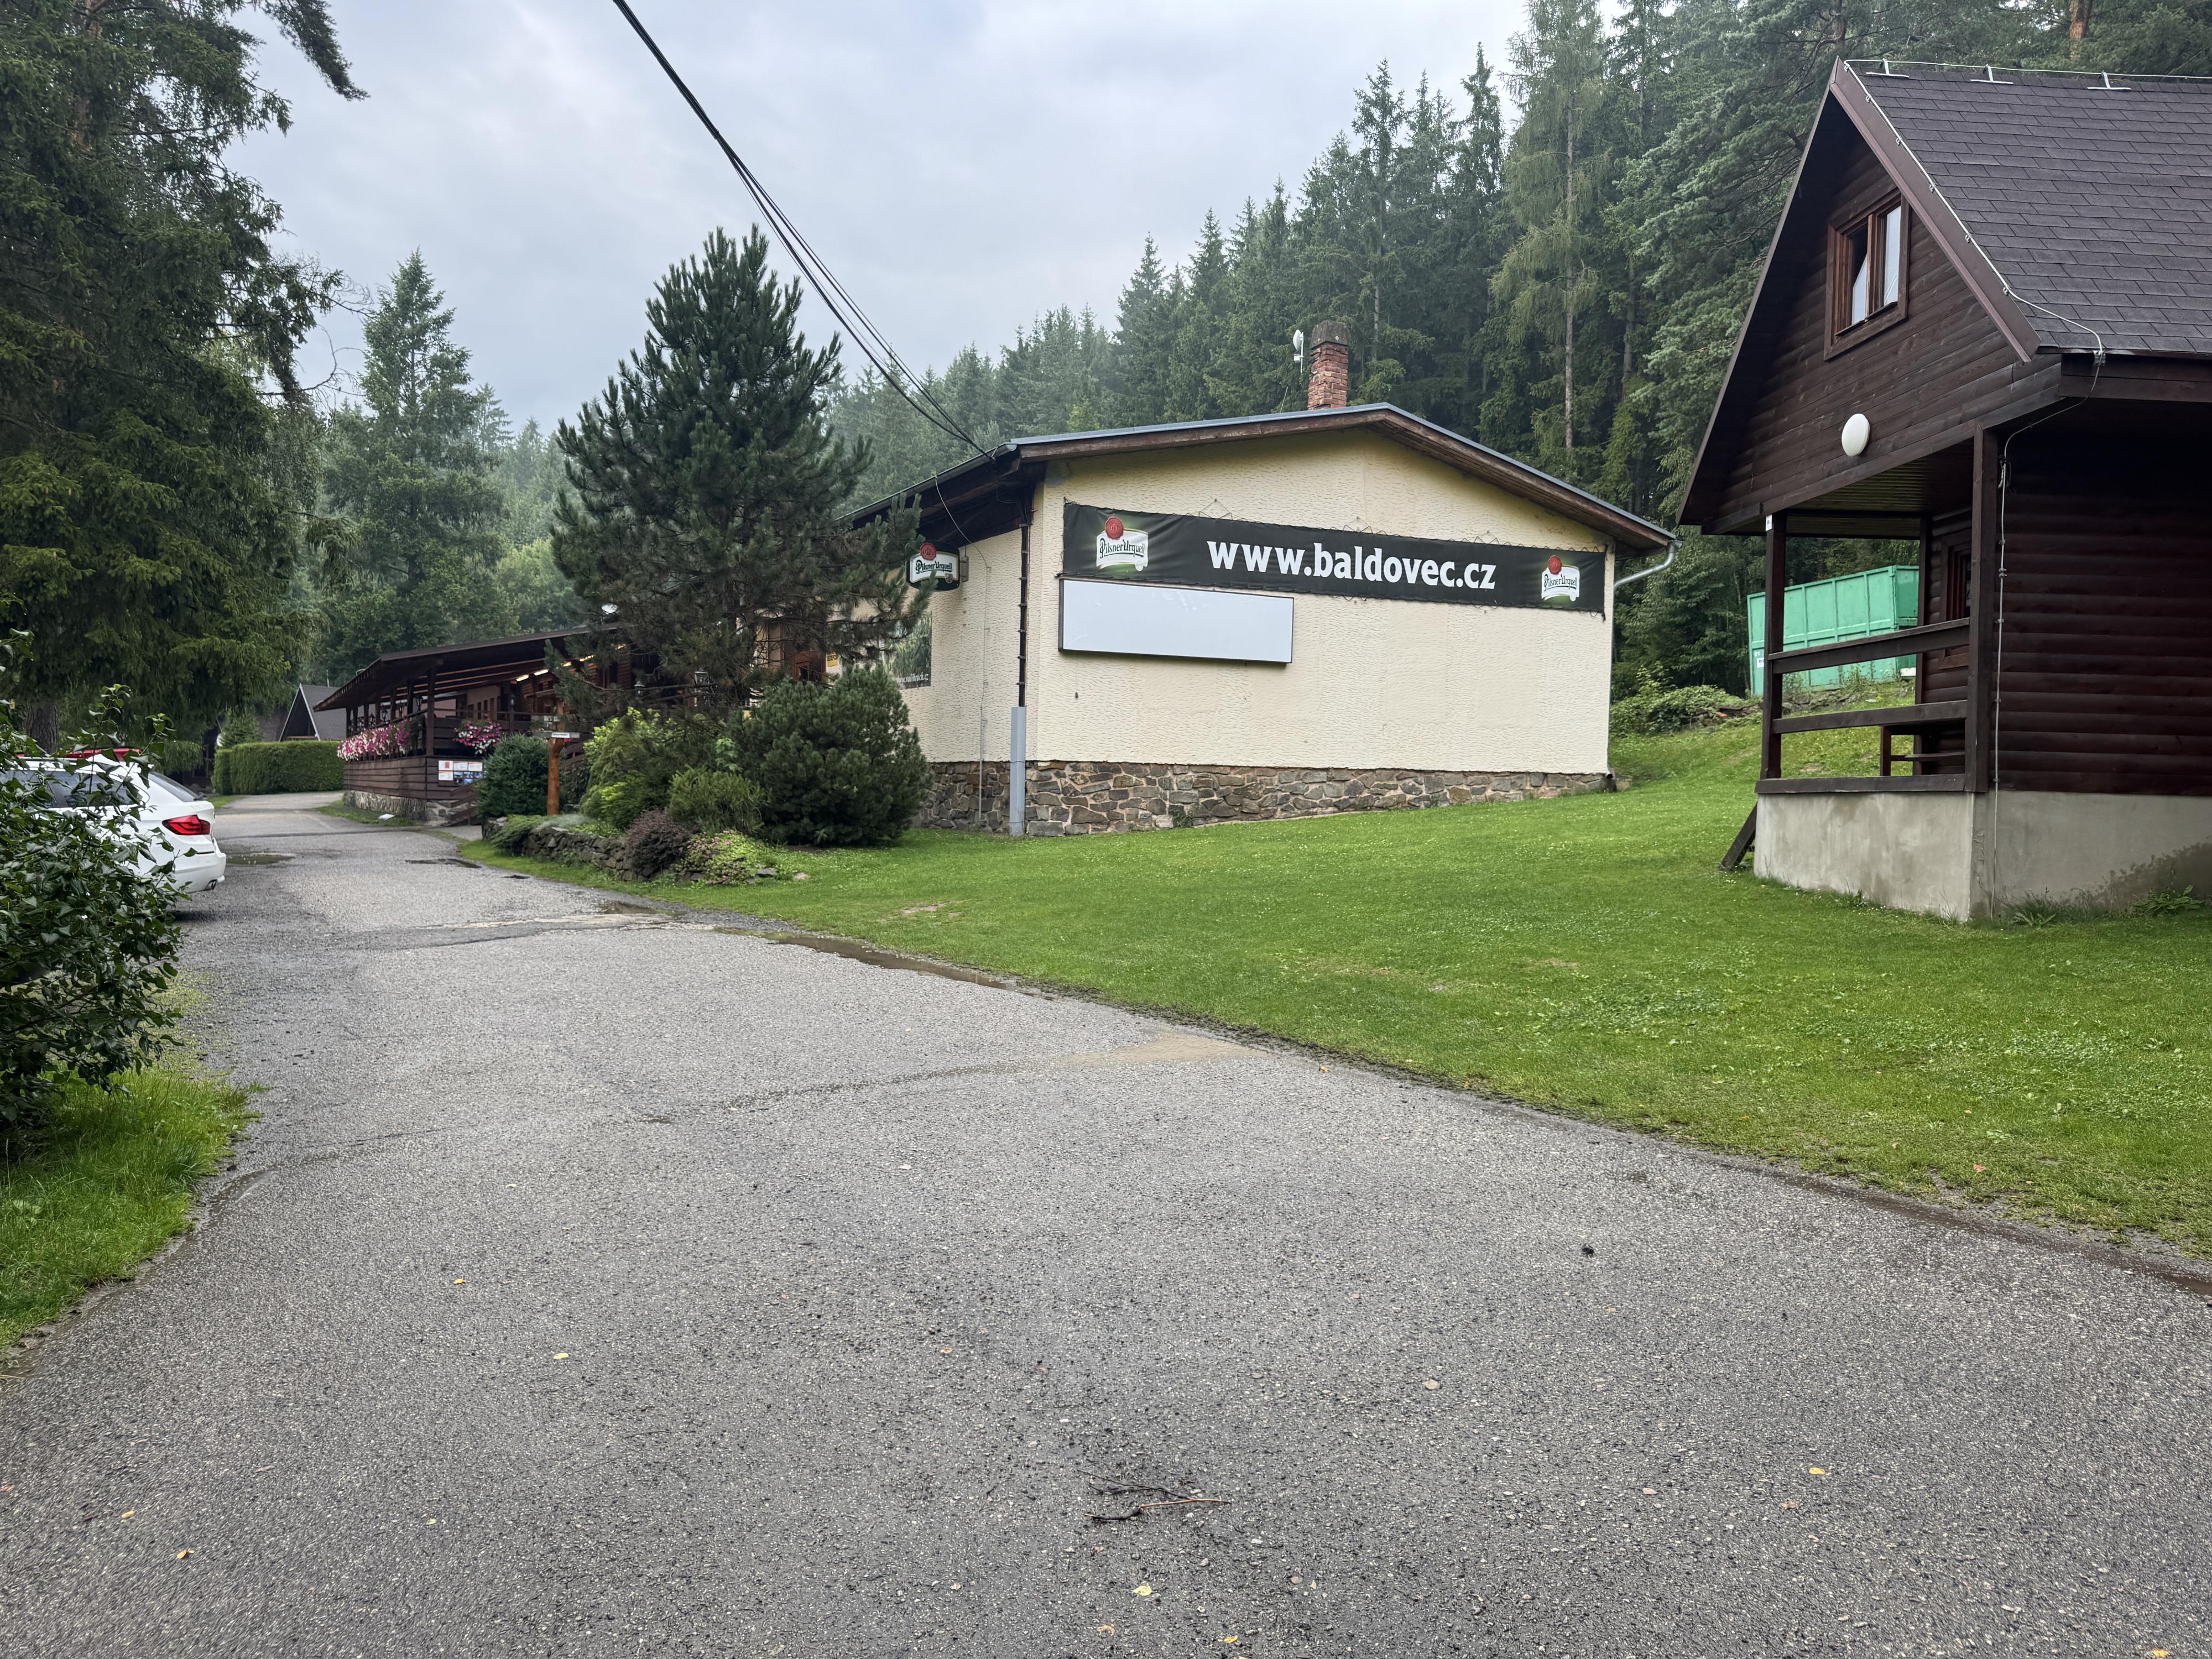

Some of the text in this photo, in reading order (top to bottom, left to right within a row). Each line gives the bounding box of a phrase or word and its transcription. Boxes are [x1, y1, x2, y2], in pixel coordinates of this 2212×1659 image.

[1099, 538, 1145, 559] Pilsner Urquell
[915, 560, 952, 574] Pilsner Urquell
[1207, 541, 1496, 589] www.baldovec.cz
